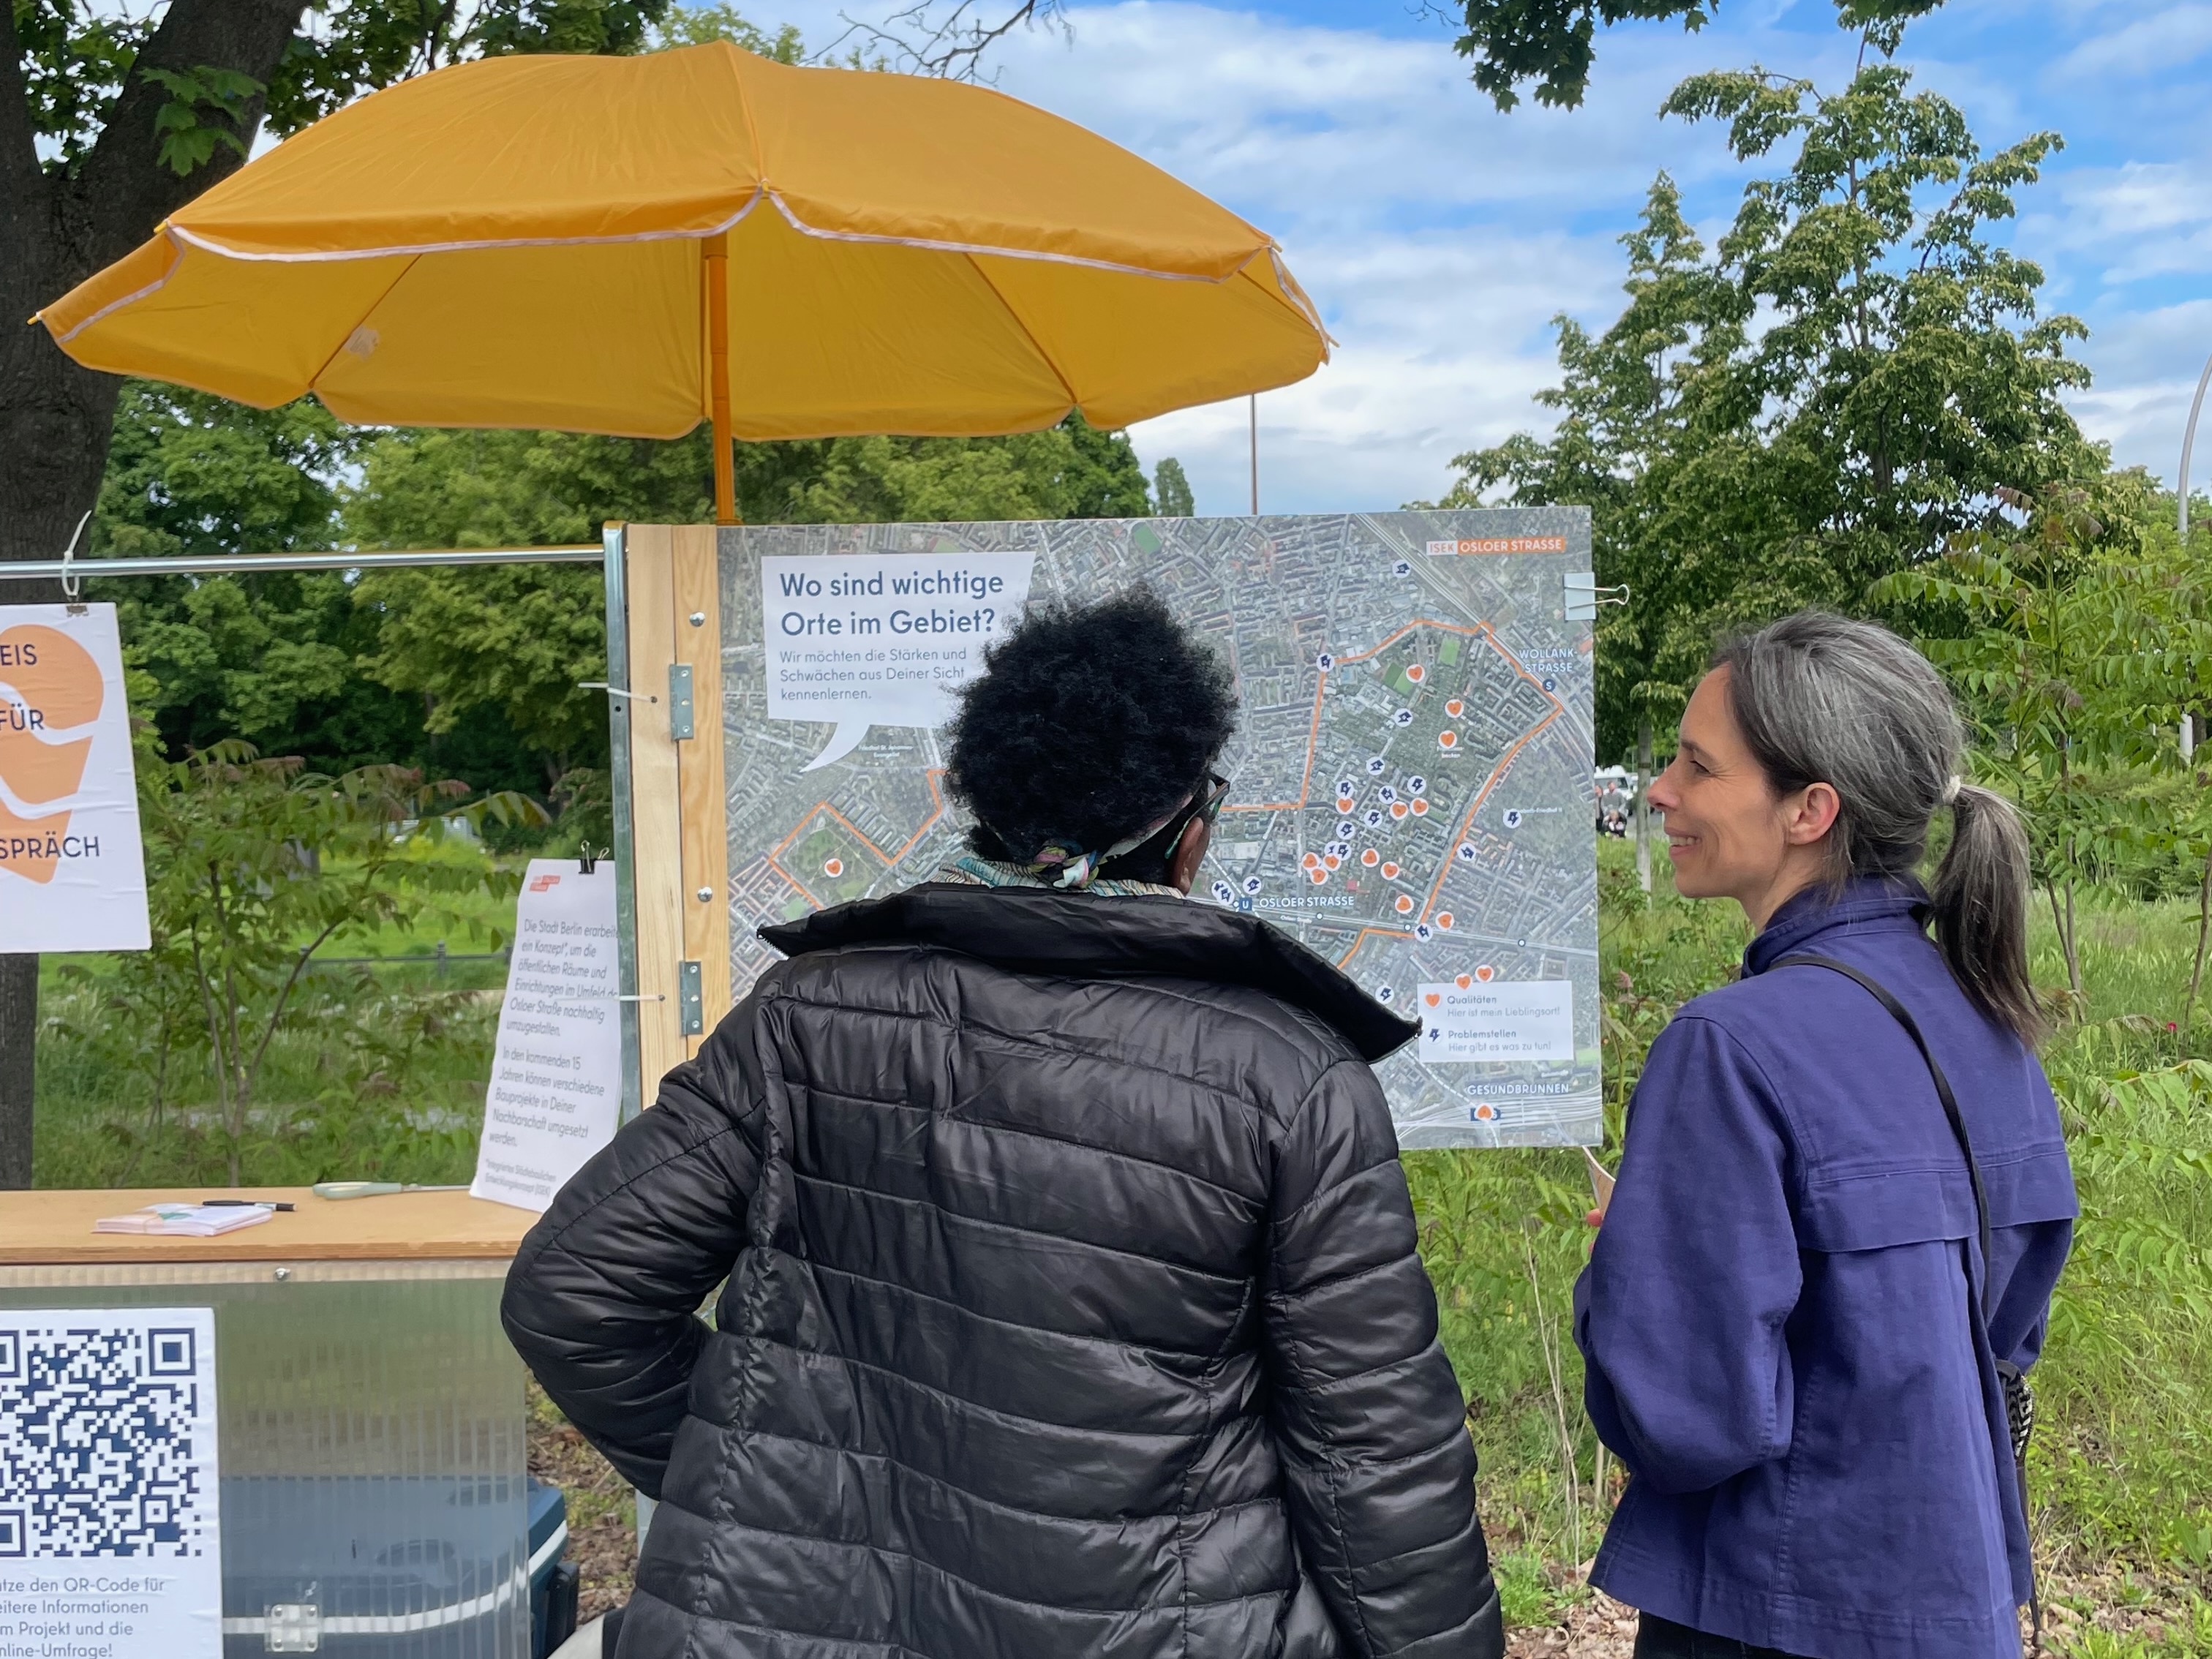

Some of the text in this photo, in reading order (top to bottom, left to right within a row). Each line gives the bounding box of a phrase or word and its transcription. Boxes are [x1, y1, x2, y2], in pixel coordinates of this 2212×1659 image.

[1430, 539, 1562, 553] ISEK OSLOER STRASSE
[780, 570, 1004, 599] Wo sind wichtige
[781, 608, 996, 636] Orte im Gebiet?
[0, 644, 37, 666] EIS
[780, 647, 966, 663] Wir möchten die Stärken und
[1519, 648, 1578, 659] WOLLANK-
[780, 666, 965, 682] Schwächen aus Deiner Sicht
[1524, 662, 1573, 674] STRASSE
[1546, 681, 1552, 691] S
[780, 688, 872, 701] kennenlernen.
[1243, 895, 1354, 909] U OSLOER STRASSE
[524, 918, 538, 933] Die
[539, 919, 559, 934] Stadt
[560, 921, 582, 936] Berlin
[570, 944, 582, 956] um
[584, 944, 597, 958] die
[562, 961, 590, 977] Räume
[591, 965, 608, 979] und
[565, 983, 575, 996] im
[1447, 996, 1497, 1004] Qualitäten
[510, 997, 606, 1025] Osloer Straße nachhaltig
[1448, 1007, 1560, 1017] Hier ist mein Lieblingsort!
[1448, 1030, 1516, 1039] Problemstellen
[1448, 1044, 1467, 1052] Hier
[1470, 1042, 1486, 1054] gibt
[1534, 1041, 1551, 1050] tun!
[511, 1049, 525, 1061] den
[526, 1050, 571, 1069] kommenden
[573, 1056, 582, 1070] 15
[499, 1066, 605, 1096] Jahren können verschiedene
[1467, 1084, 1569, 1096] GESUNDBRUNNEN
[495, 1088, 541, 1107] Bauprojekte
[550, 1096, 576, 1114] Deiner
[493, 1108, 547, 1129] Nachbarschaft
[0, 1577, 165, 1592] tze den QR-Code für
[42, 1598, 148, 1614] Informationen
[19, 1621, 70, 1639] Projekt
[75, 1621, 105, 1636] und
[109, 1621, 133, 1635] die
